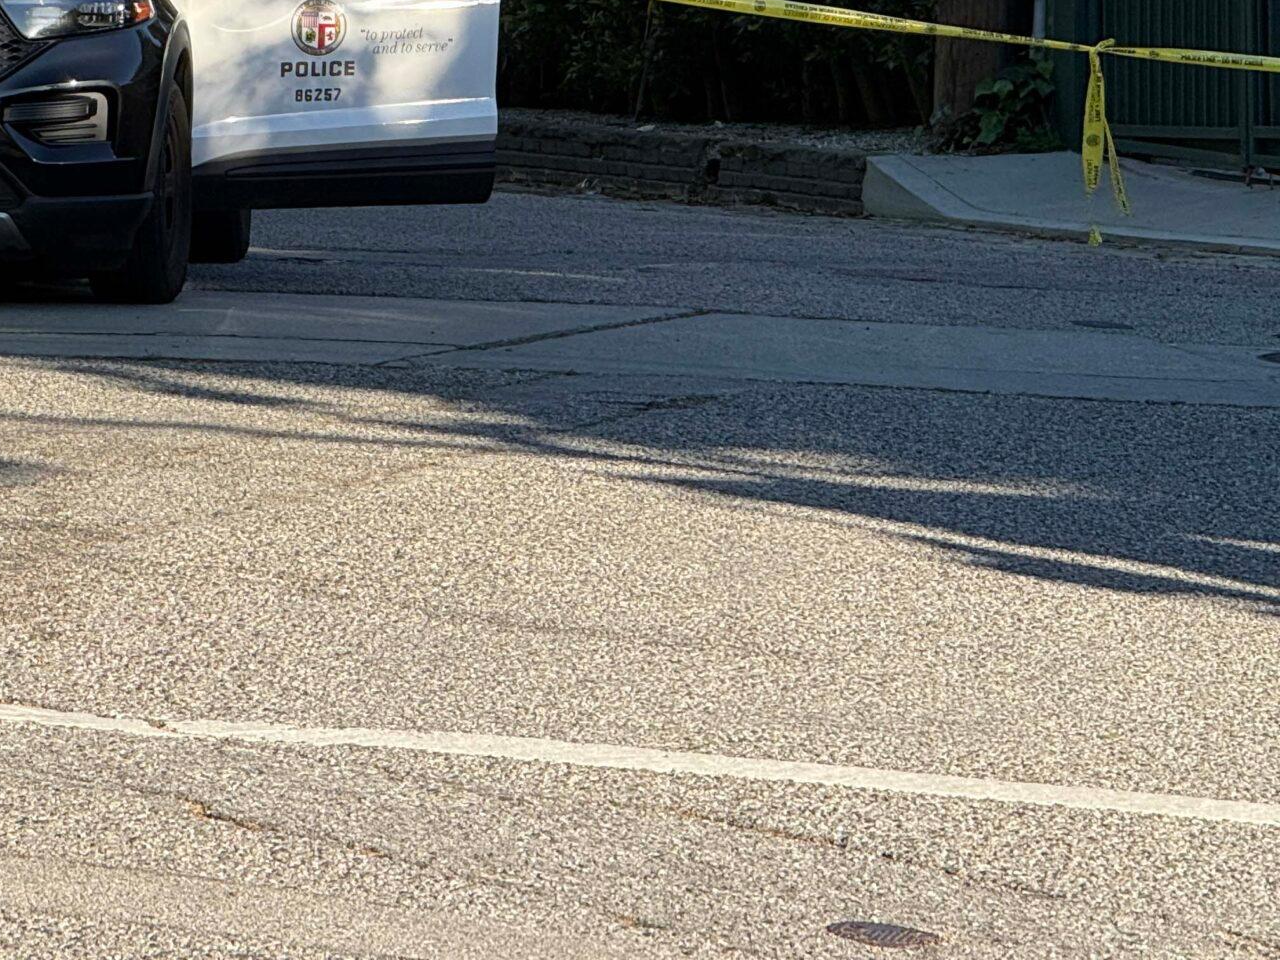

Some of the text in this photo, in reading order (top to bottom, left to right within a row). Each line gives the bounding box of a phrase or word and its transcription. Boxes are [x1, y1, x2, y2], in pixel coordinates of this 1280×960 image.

[380, 26, 424, 43] protect
[372, 40, 398, 55] and
[400, 38, 413, 53] to
[280, 60, 356, 78] POLICE
[295, 87, 342, 102] 86257
